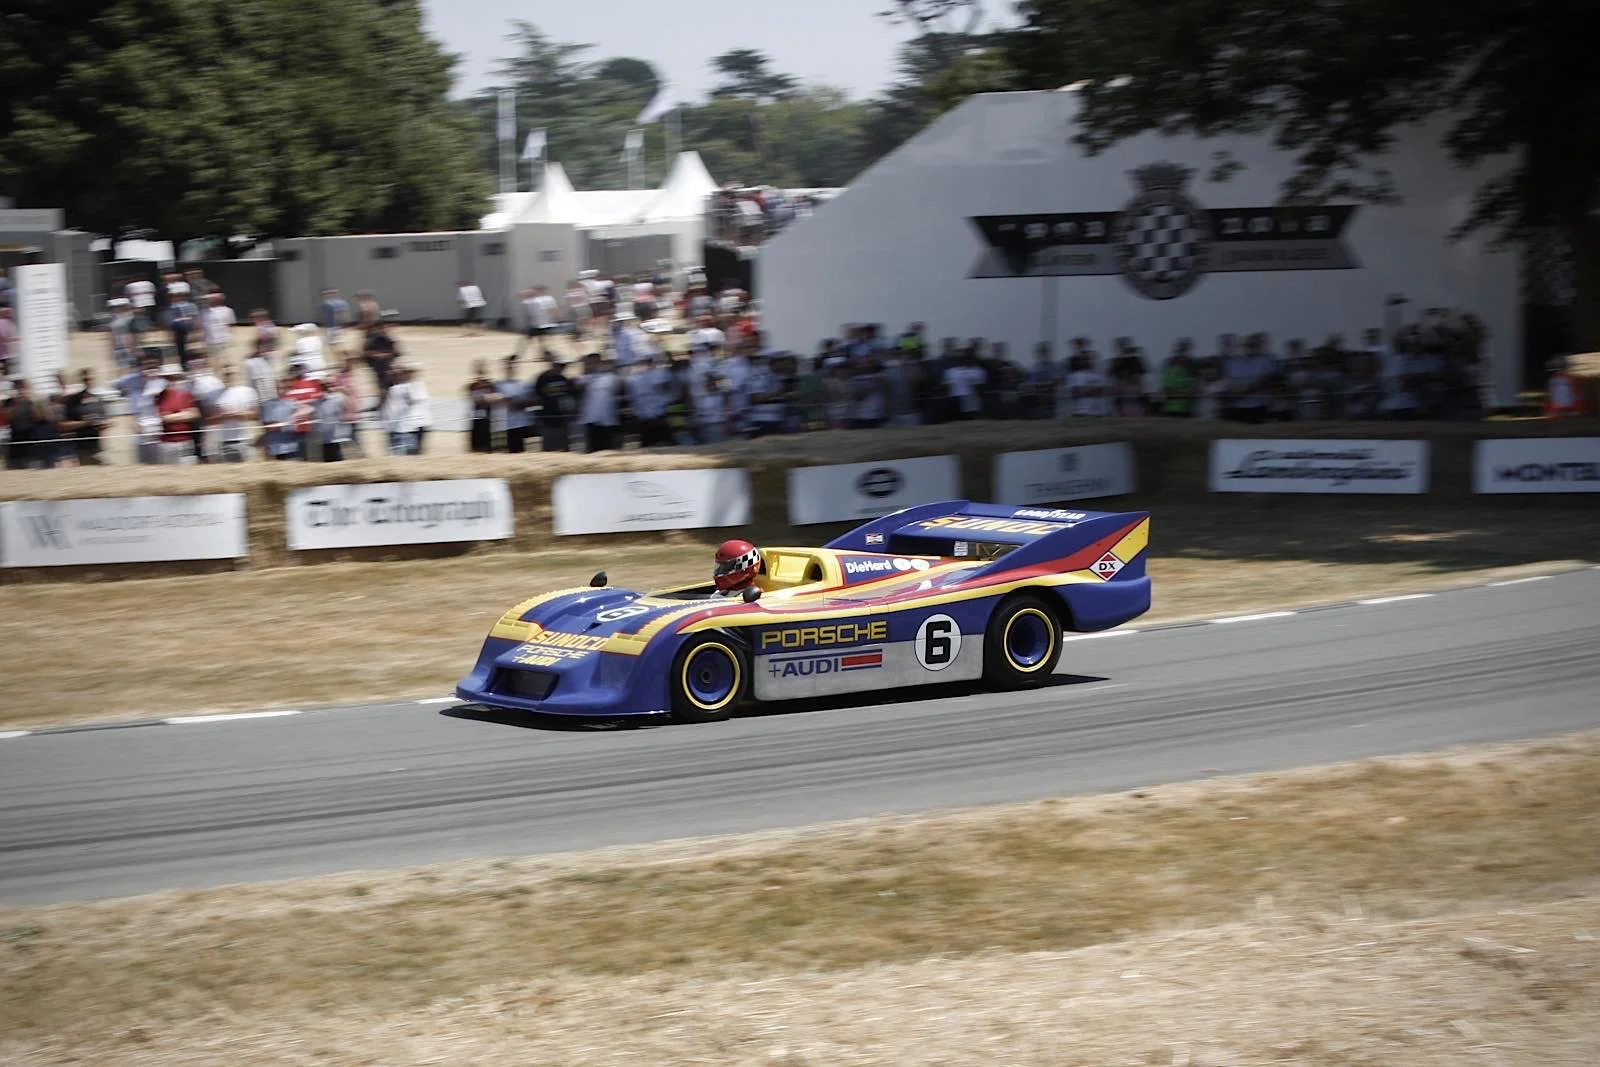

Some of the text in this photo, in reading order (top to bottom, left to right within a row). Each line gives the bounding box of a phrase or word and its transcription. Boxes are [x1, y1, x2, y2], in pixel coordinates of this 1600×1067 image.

[919, 515, 1067, 535] SUNOC
[845, 560, 892, 574] DieHard
[1099, 562, 1116, 571] DX
[524, 631, 610, 651] SUNOCO
[761, 620, 887, 649] PORSCHE
[925, 620, 952, 664] 6
